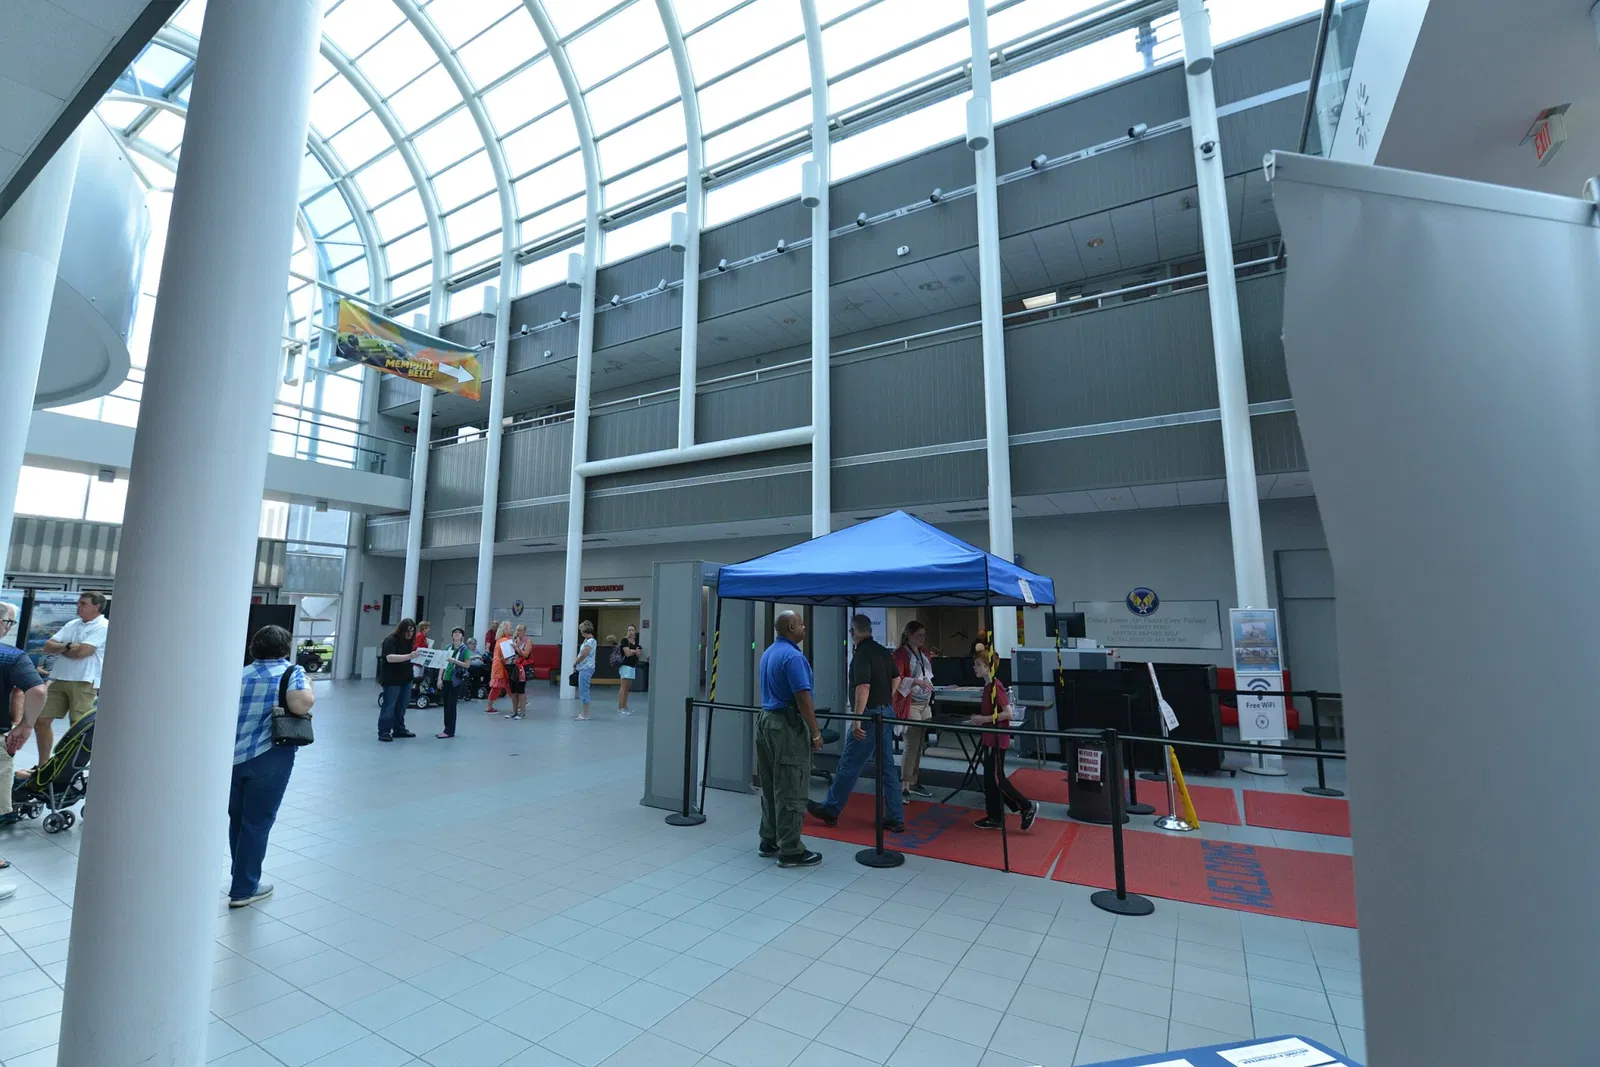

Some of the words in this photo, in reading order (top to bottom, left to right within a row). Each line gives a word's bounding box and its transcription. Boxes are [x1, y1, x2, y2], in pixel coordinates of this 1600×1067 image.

[1534, 120, 1552, 160] EXIT
[385, 359, 434, 370] MEMPHIS
[408, 369, 435, 379] BELLE
[584, 584, 624, 592] INFORMATION
[1261, 701, 1276, 709] WiFi
[1201, 840, 1276, 909] WELCOME
